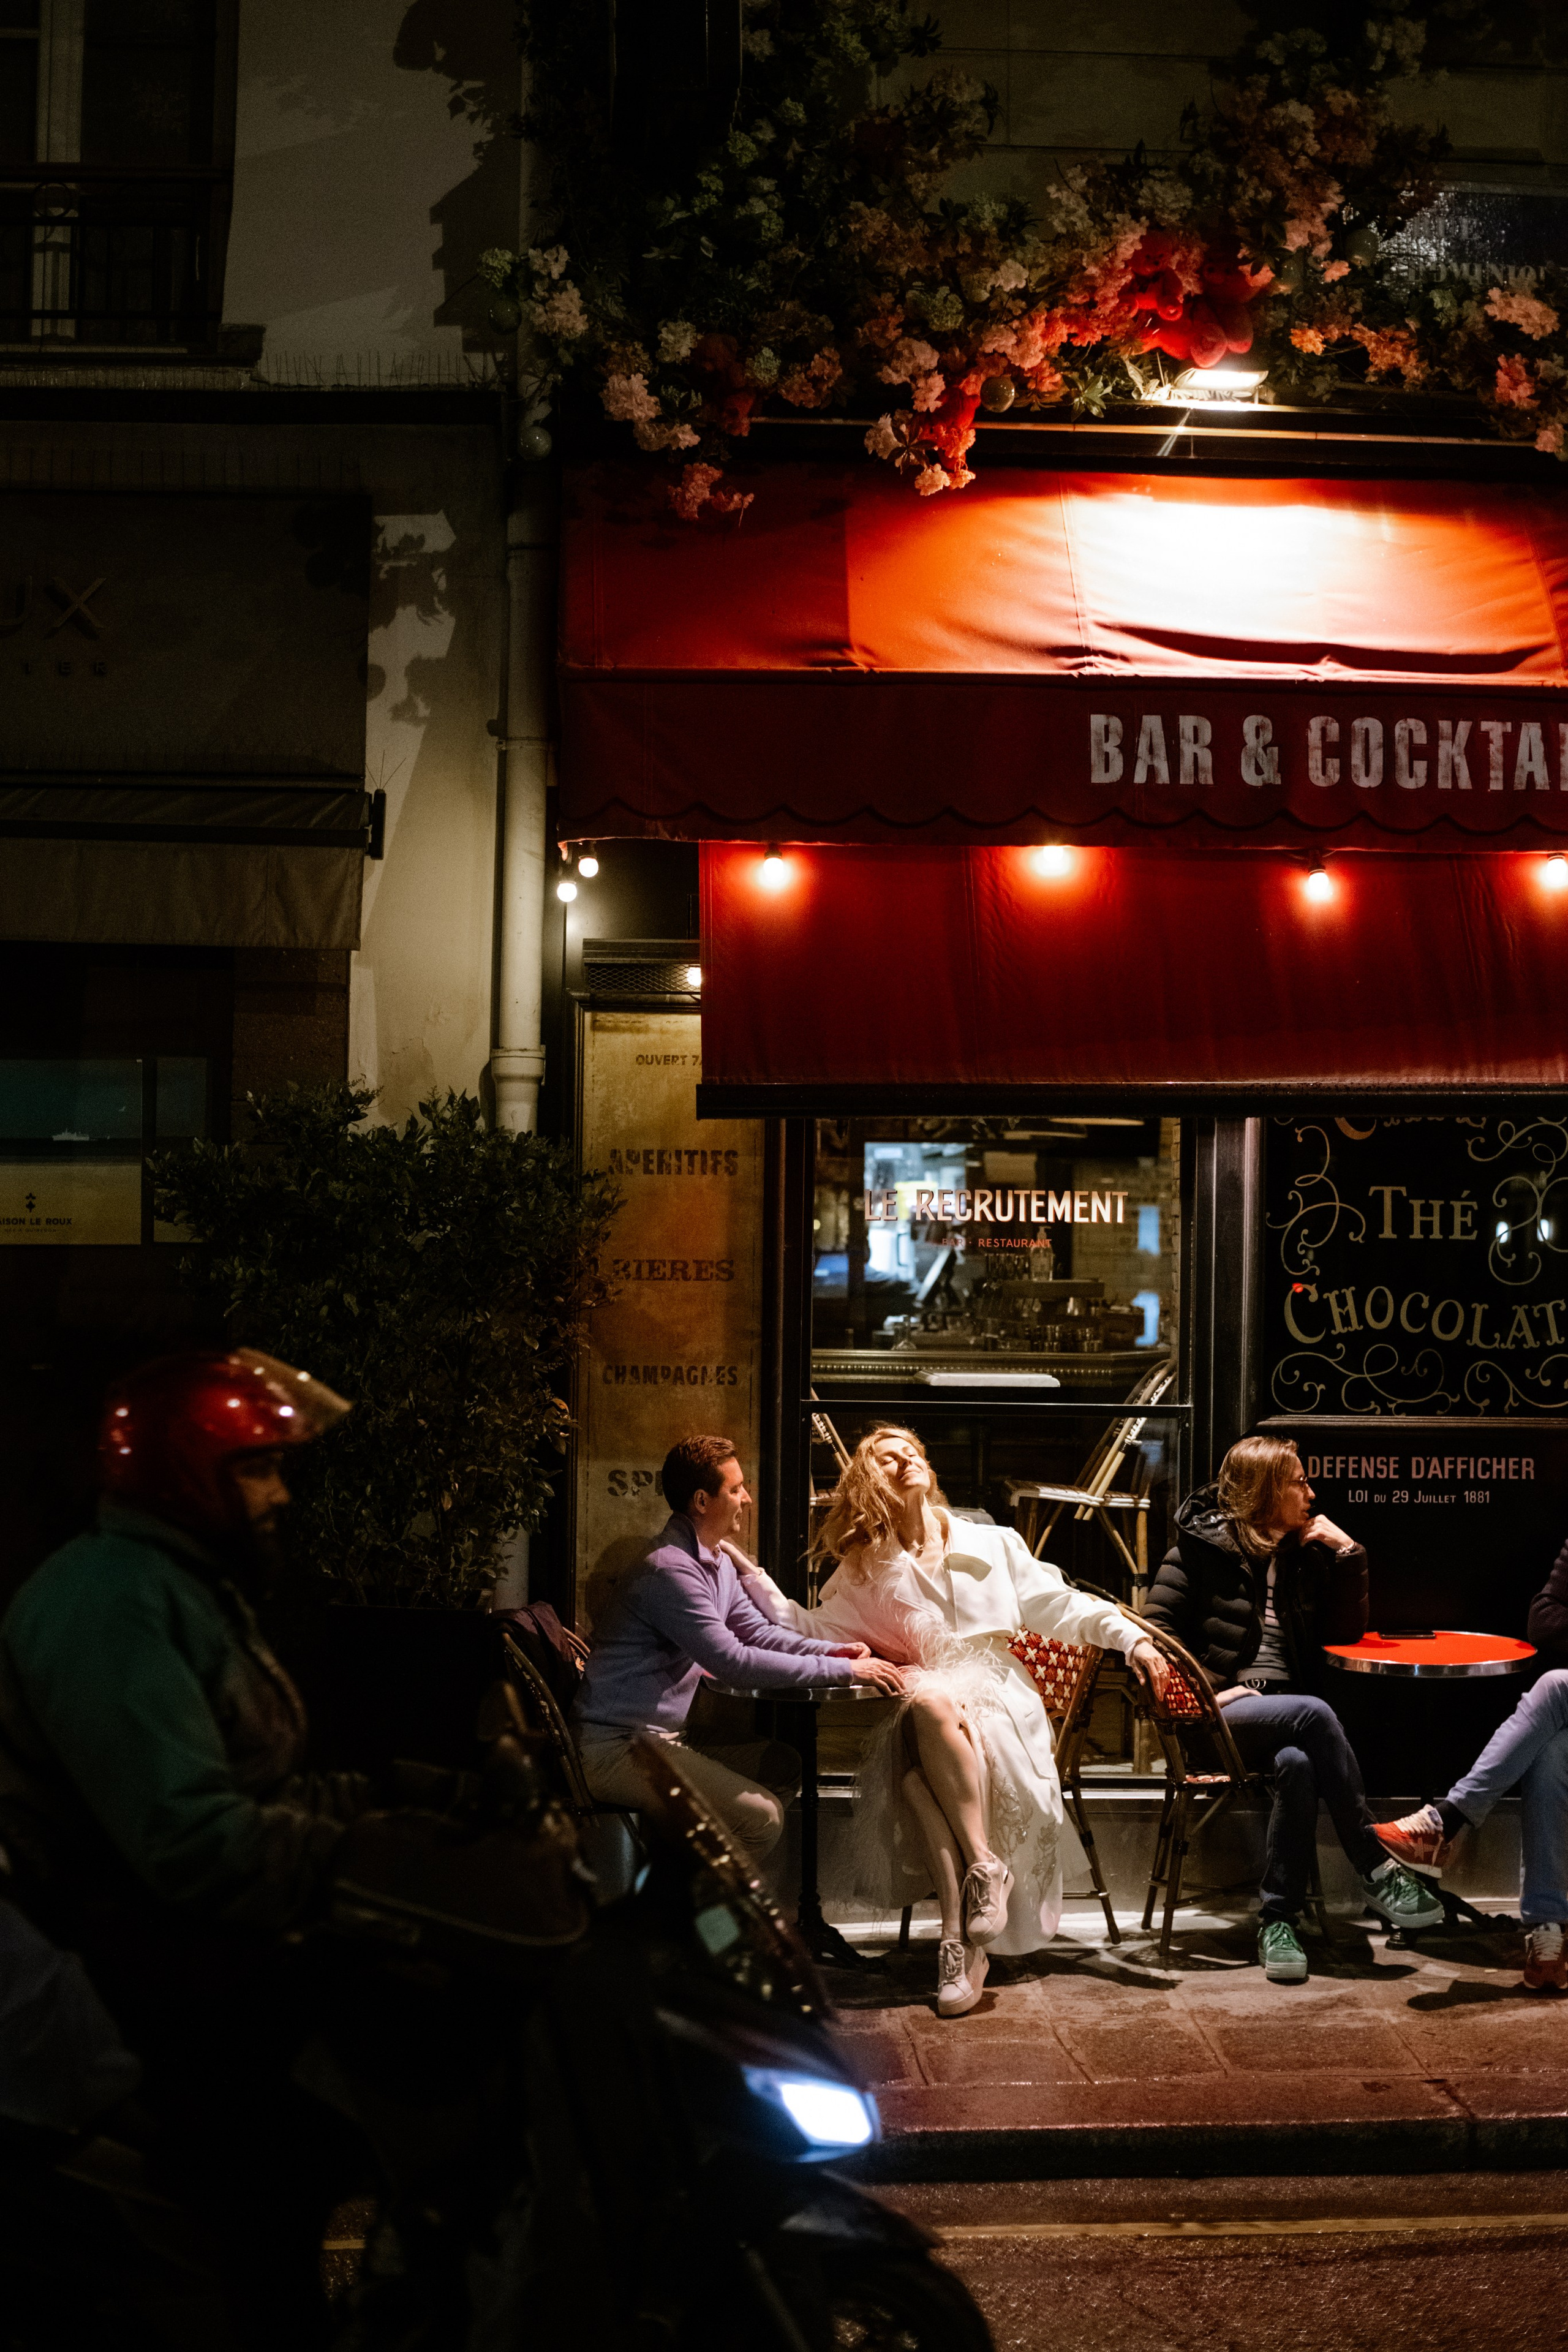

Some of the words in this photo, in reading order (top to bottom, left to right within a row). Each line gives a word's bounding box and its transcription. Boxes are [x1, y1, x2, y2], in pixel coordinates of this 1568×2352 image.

[1090, 714, 1214, 785] BAR
[1241, 714, 1281, 787] &
[636, 1054, 687, 1066] OUVERT
[864, 1189, 898, 1221] LE
[916, 1189, 1129, 1224] RECRUTEMENT
[1368, 1186, 1479, 1241] THÉ
[942, 1238, 963, 1248] BAR
[978, 1238, 1052, 1248] RESTAURANT
[1283, 1283, 1567, 1349] CHOCOLAT
[1308, 1455, 1400, 1479] DEFENSE
[1411, 1456, 1535, 1480] D'AFFICHER
[1348, 1490, 1368, 1503] LOI
[1392, 1490, 1409, 1504] 29
[1463, 1490, 1490, 1504] 1881
